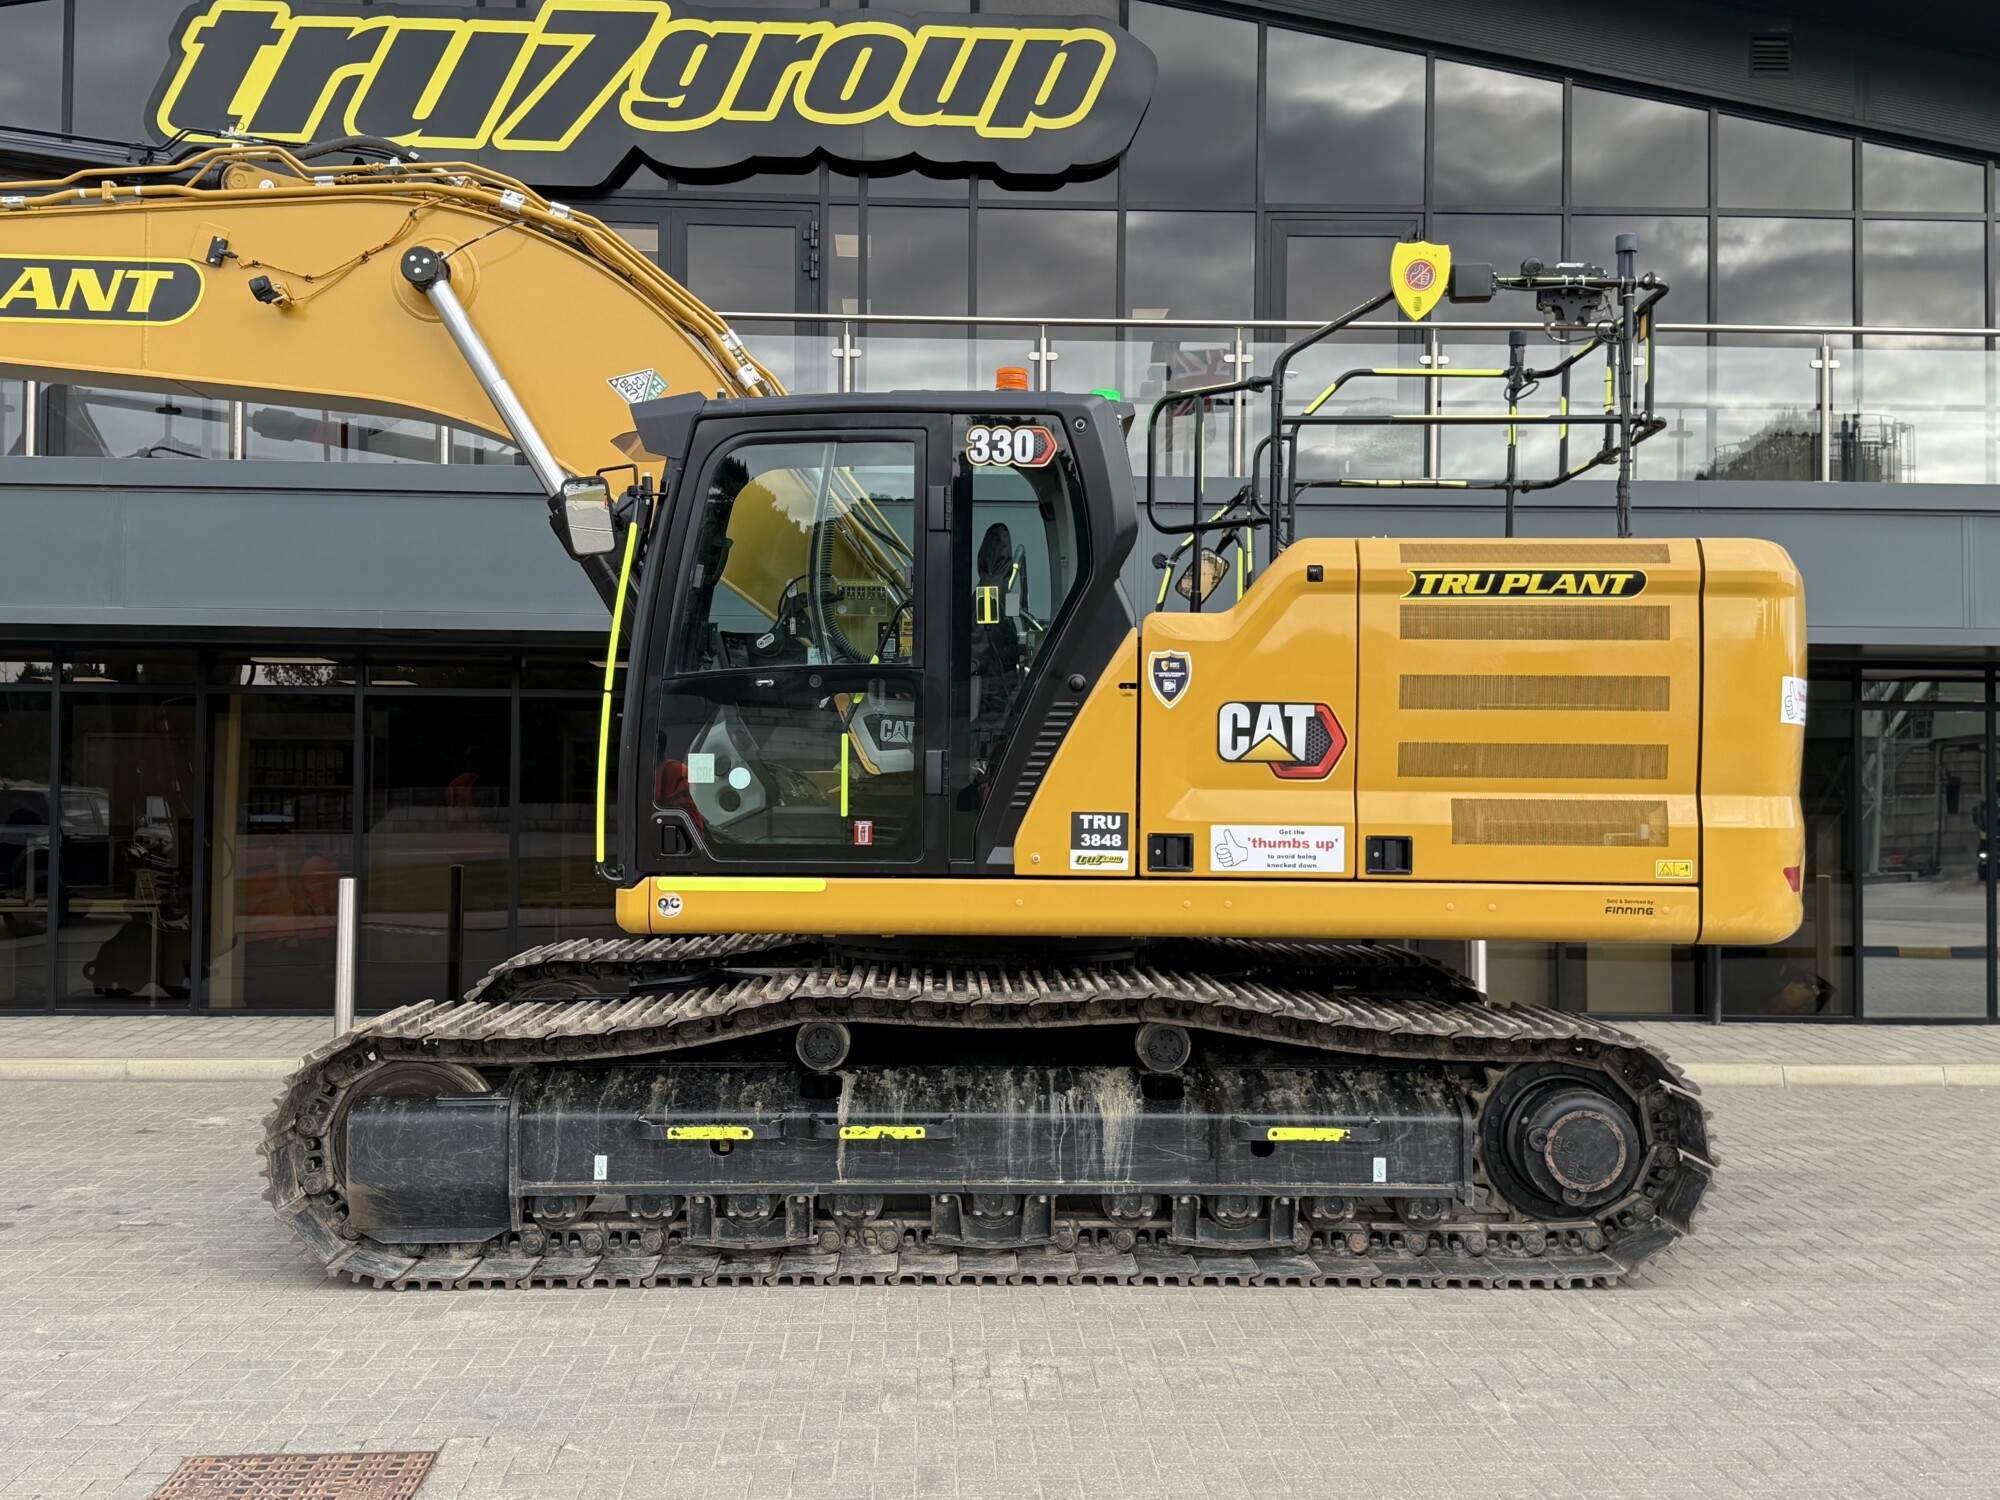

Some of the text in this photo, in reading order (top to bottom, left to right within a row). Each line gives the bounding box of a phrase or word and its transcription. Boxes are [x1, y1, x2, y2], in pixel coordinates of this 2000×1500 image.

[0, 267, 174, 313] ANT
[969, 428, 1035, 463] 330
[1419, 573, 1634, 595] TRU PLANT
[880, 719, 915, 744] CAT
[1219, 702, 1315, 761] CAT
[1079, 814, 1121, 830] TRU
[1080, 833, 1122, 847] 3848
[1248, 837, 1339, 852] 'thumbs up'
[1605, 906, 1654, 915] FINNING
